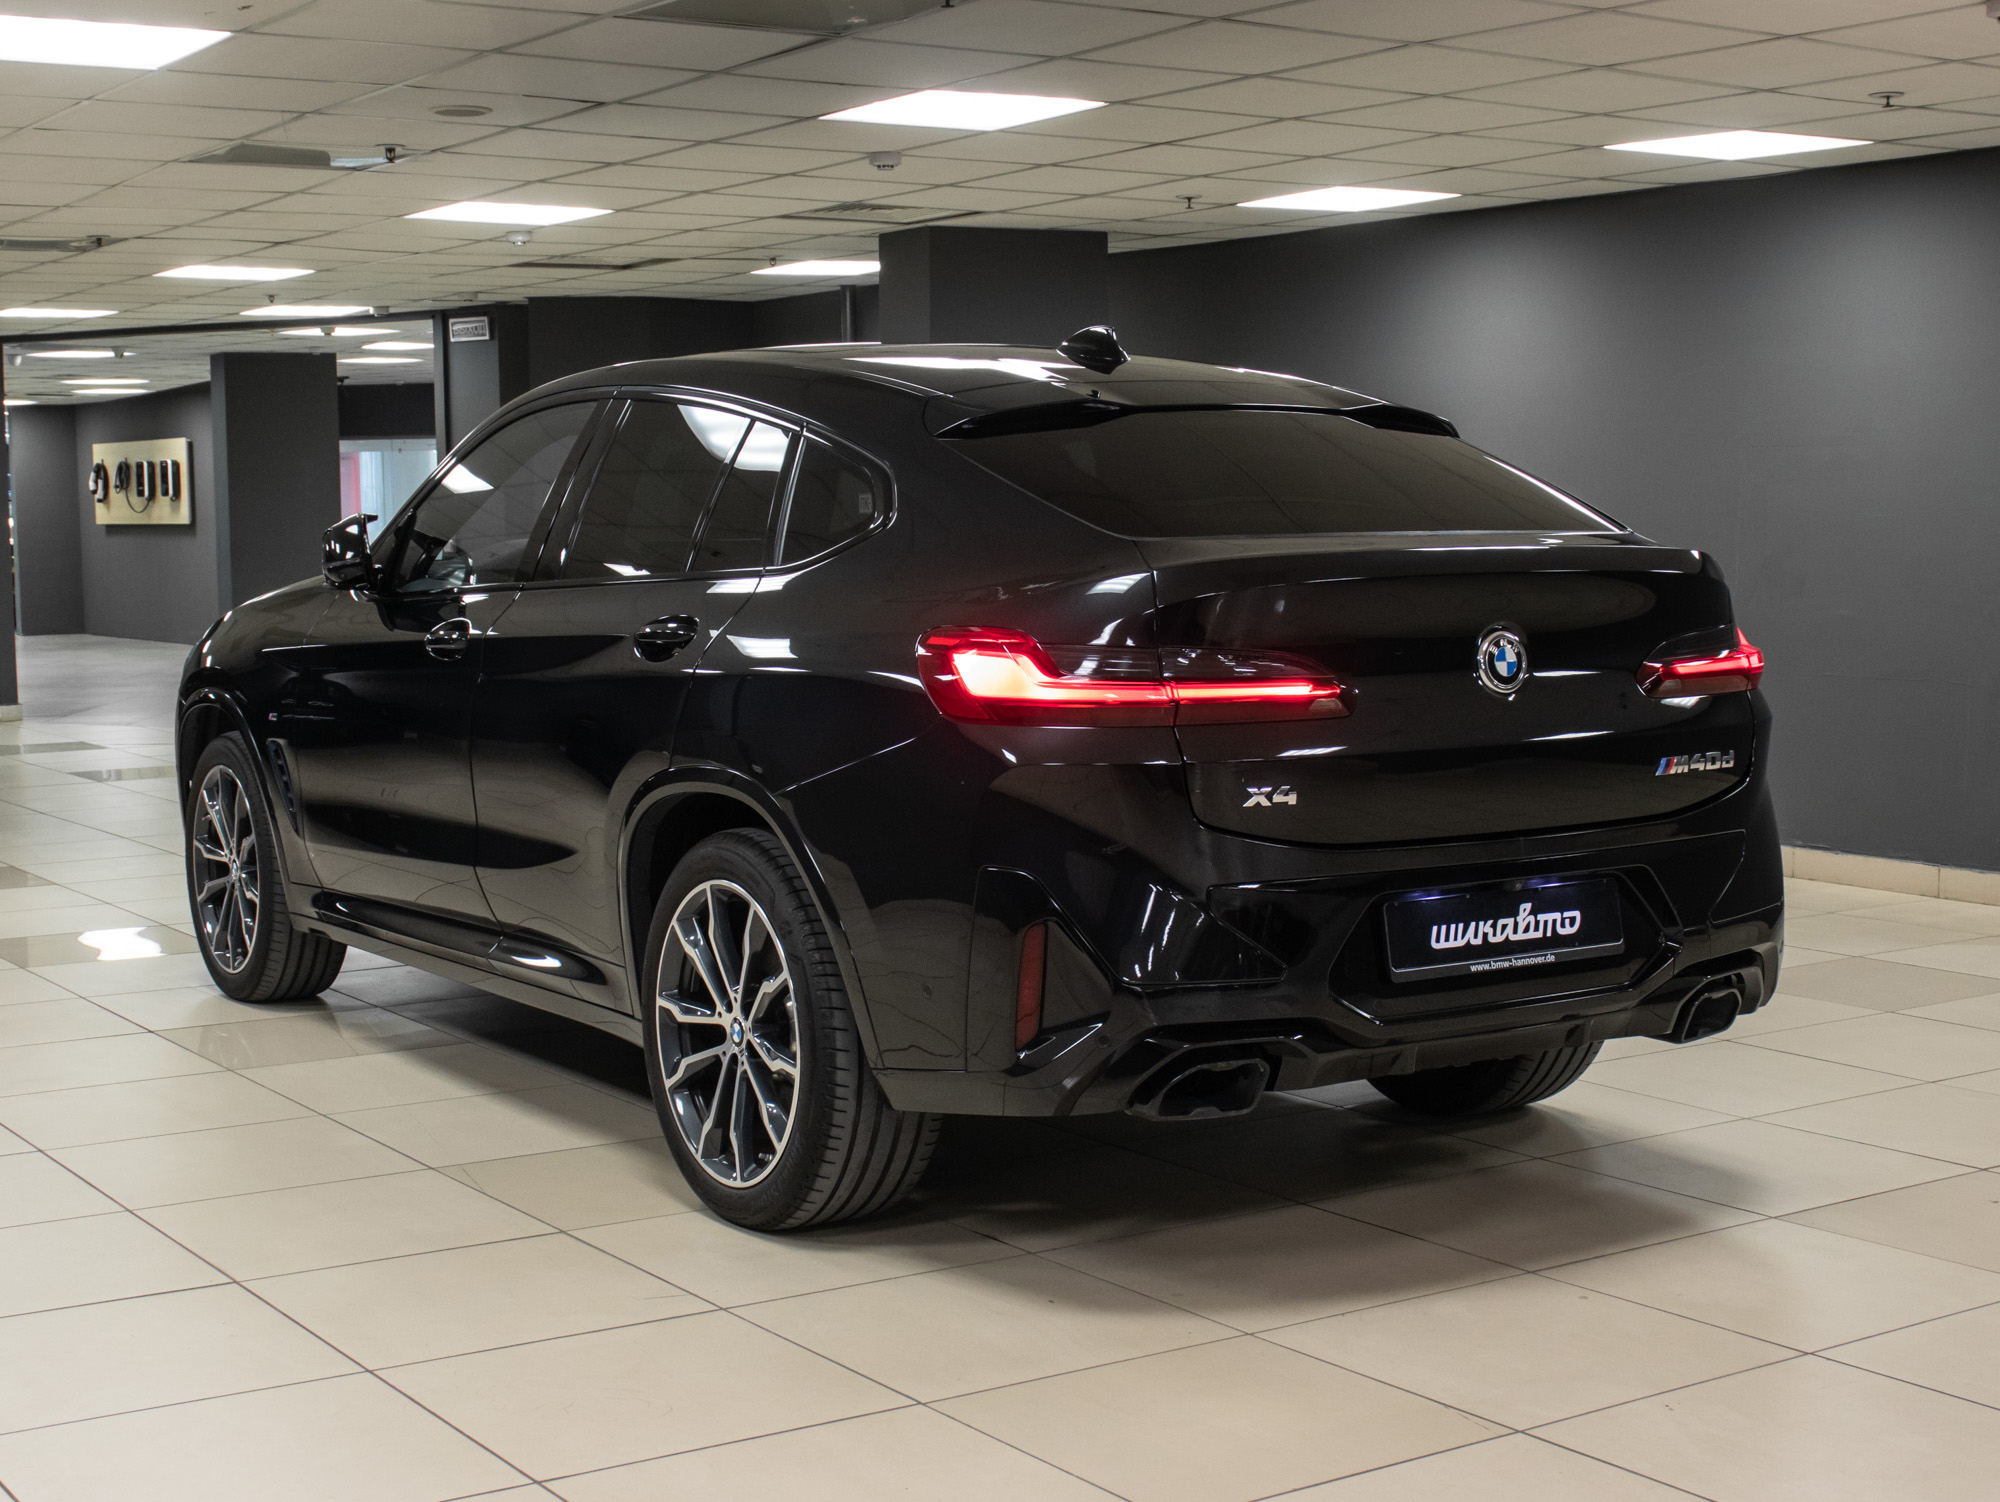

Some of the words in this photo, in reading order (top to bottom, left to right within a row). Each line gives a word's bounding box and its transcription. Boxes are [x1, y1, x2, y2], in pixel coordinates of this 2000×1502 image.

[1668, 750, 1735, 774] M40d
[1243, 785, 1297, 807] X4
[1470, 953, 1556, 972] www.bmw-hannover.de
